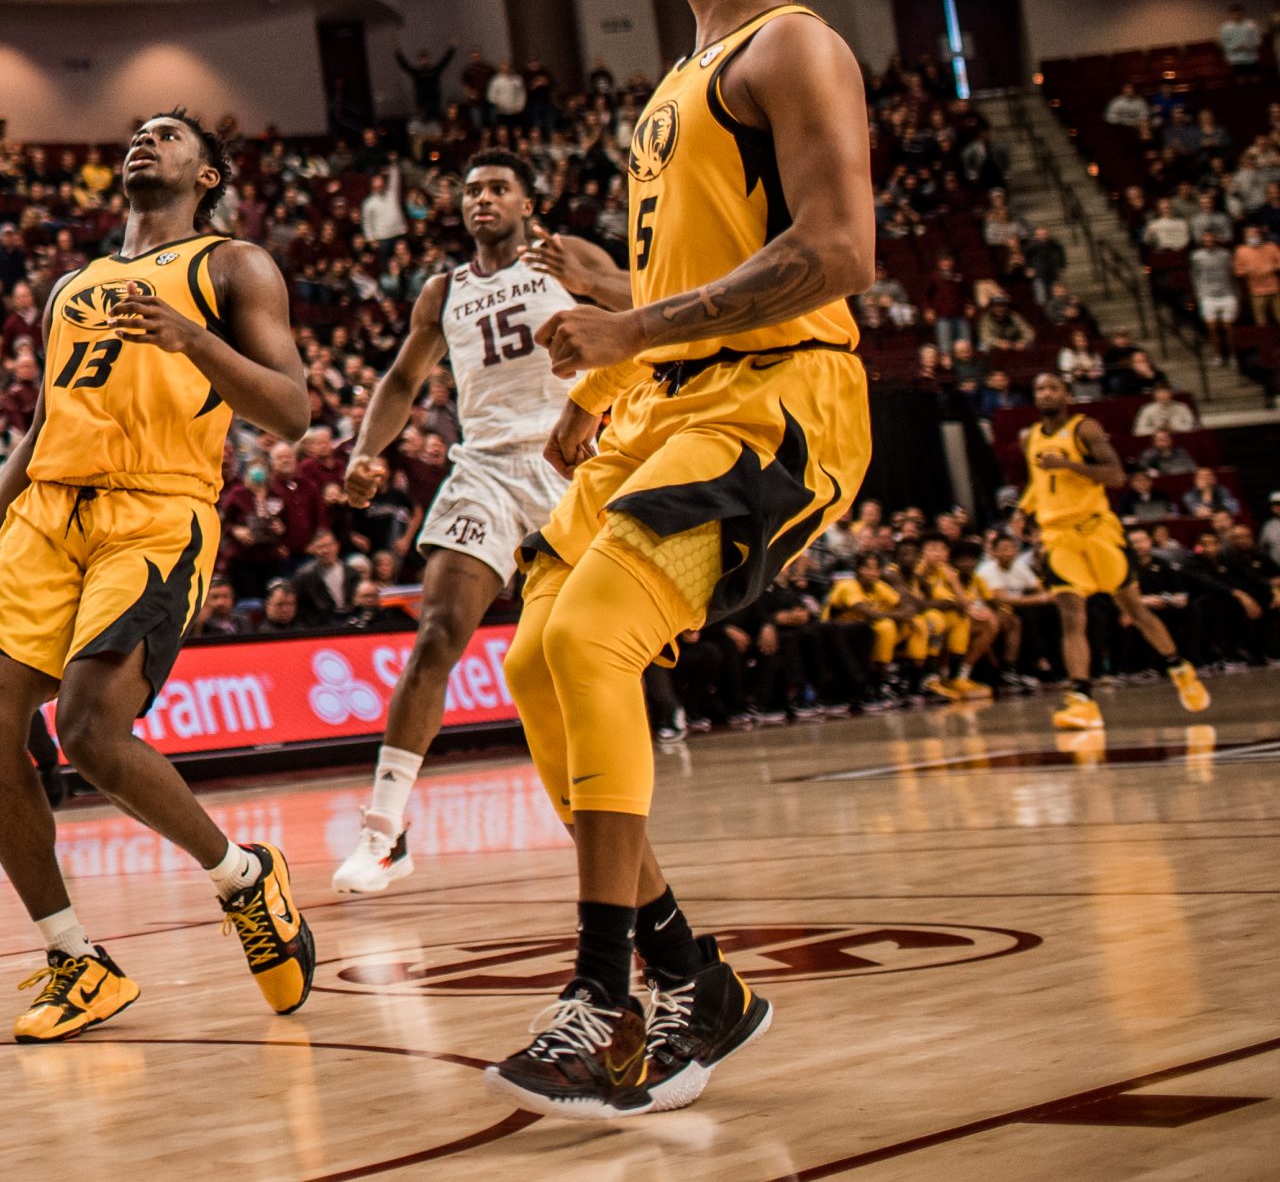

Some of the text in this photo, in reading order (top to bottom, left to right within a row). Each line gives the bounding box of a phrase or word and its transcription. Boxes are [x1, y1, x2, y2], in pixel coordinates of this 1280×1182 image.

[636, 194, 658, 271] 5
[453, 278, 547, 320] TEXAS A&M
[53, 338, 123, 389] 13
[476, 303, 535, 367] 15
